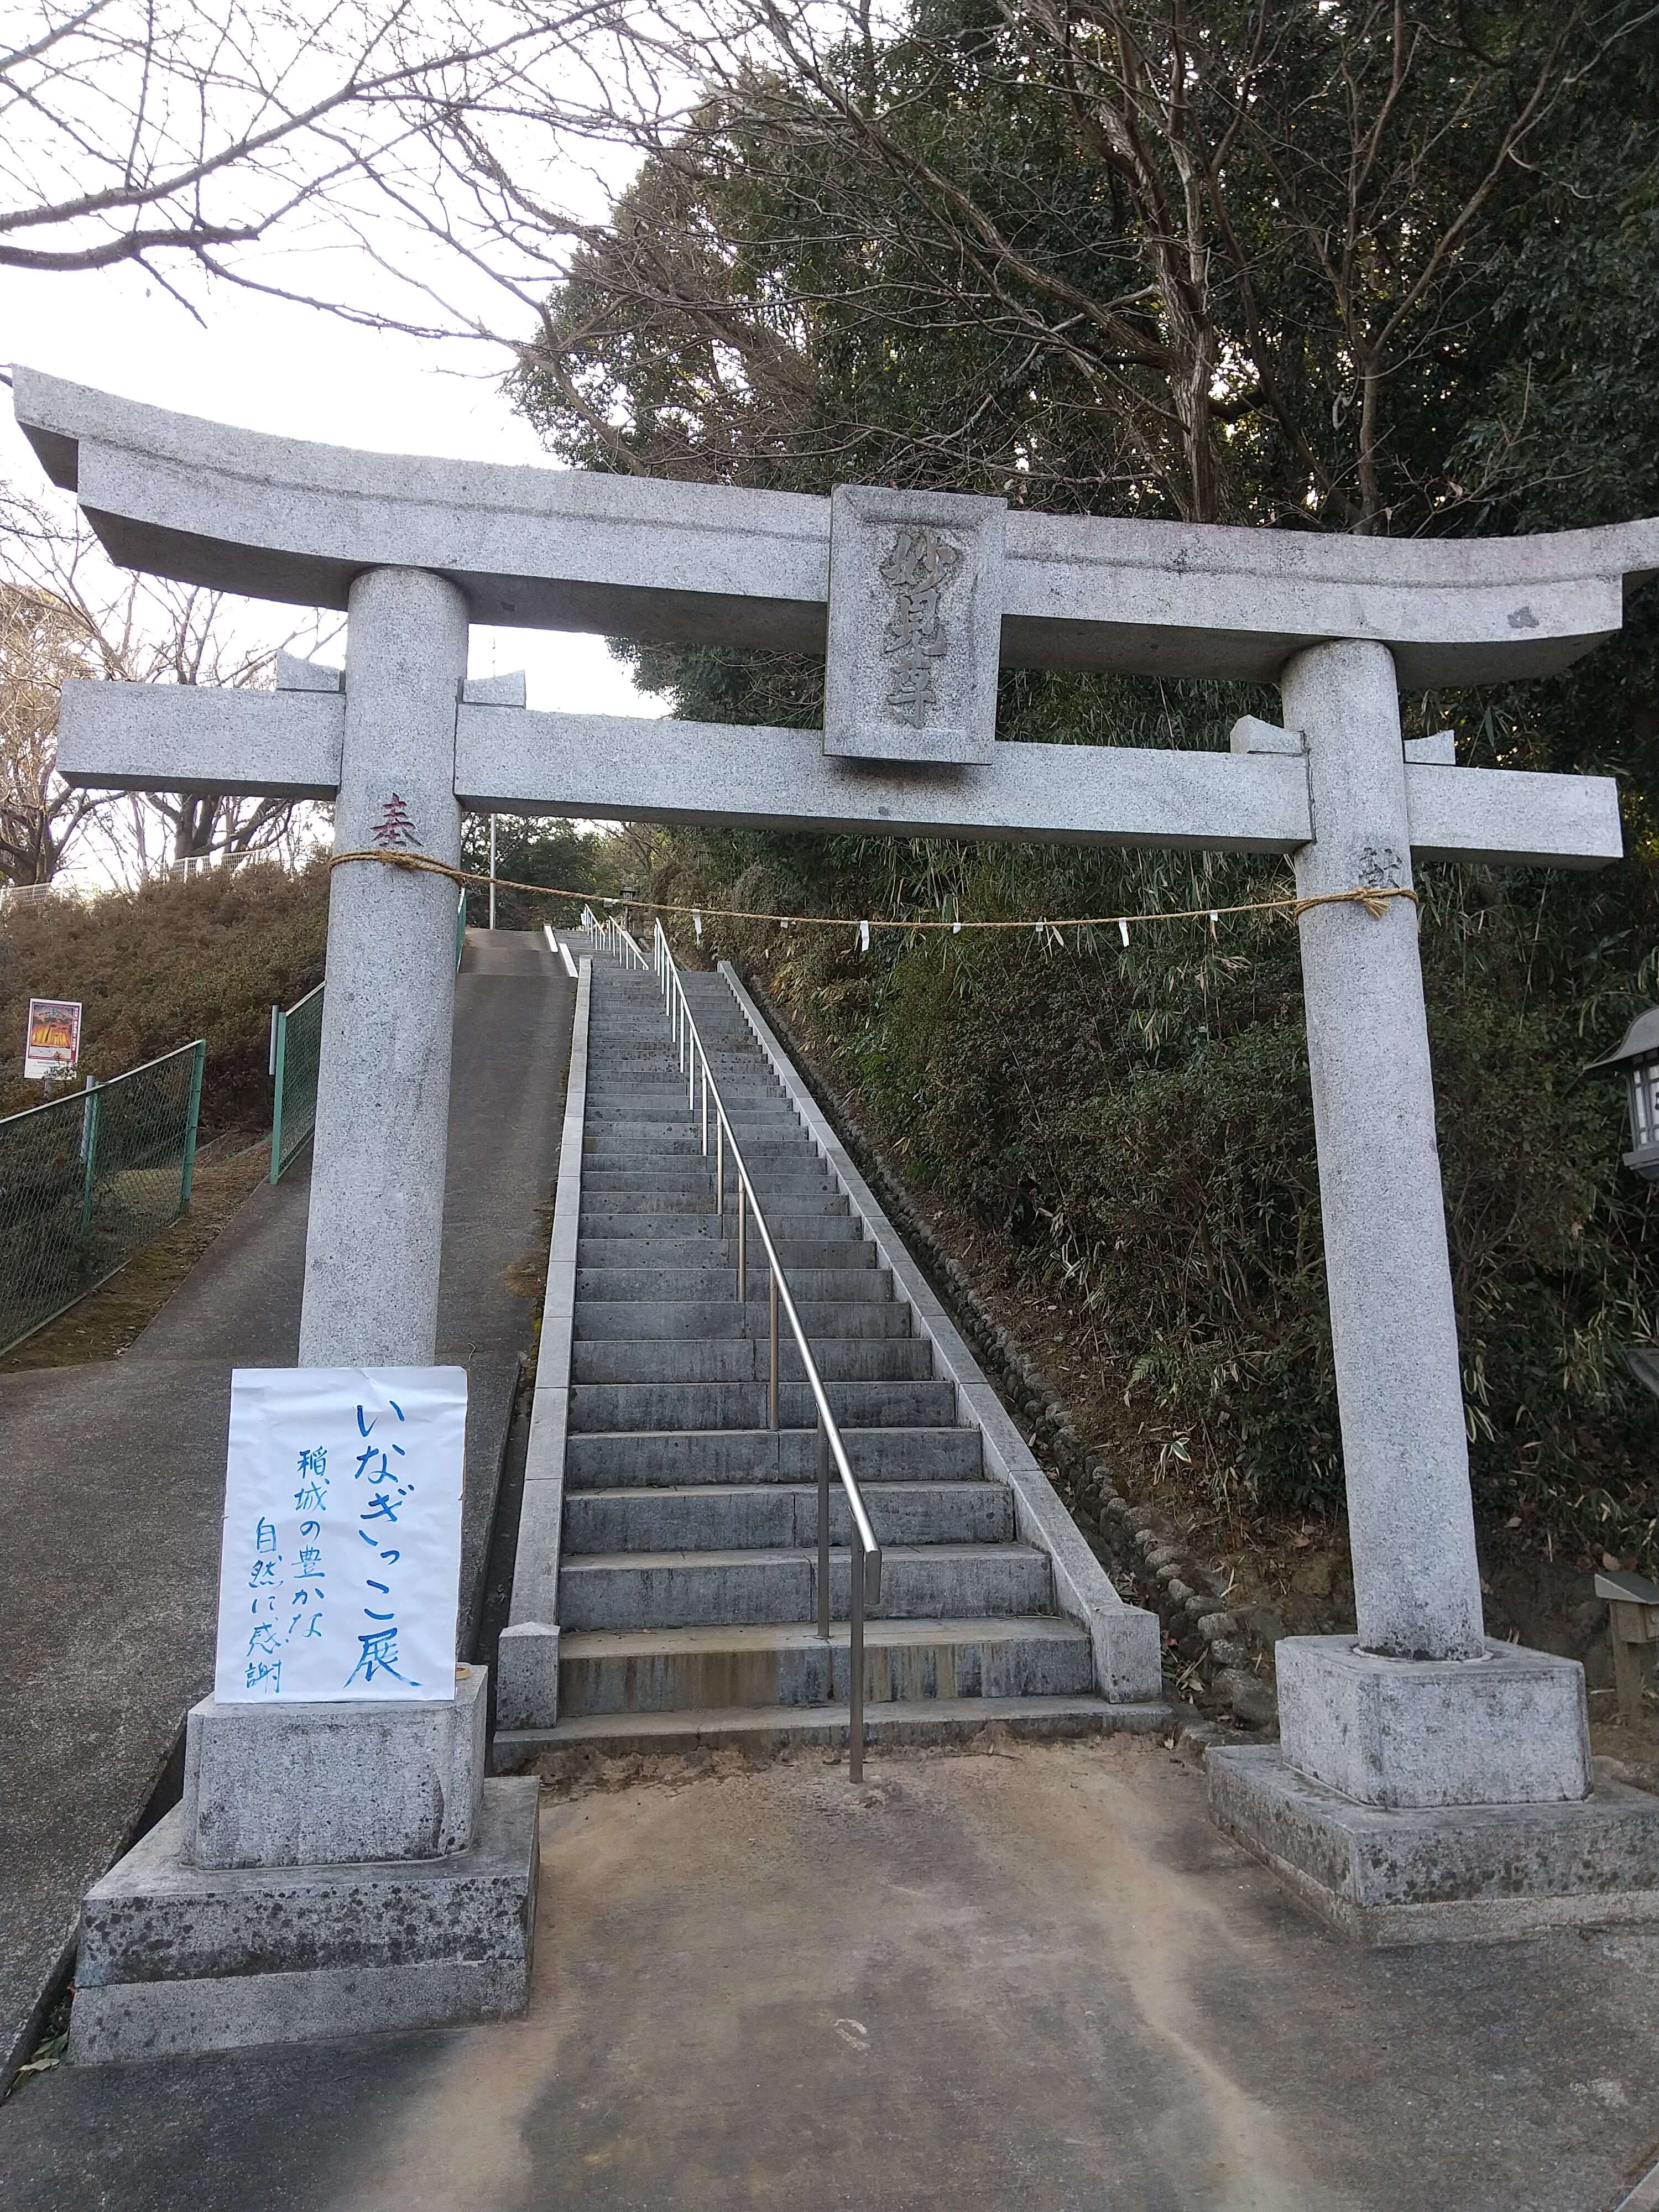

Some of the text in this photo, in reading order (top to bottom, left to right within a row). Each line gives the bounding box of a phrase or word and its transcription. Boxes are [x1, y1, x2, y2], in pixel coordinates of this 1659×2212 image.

[370, 792, 424, 848] 奉
[245, 1516, 290, 1694] 自然に感謝
[288, 1445, 331, 1638] 稲城の豊かな
[345, 1400, 425, 1688] いなぎっこ展
